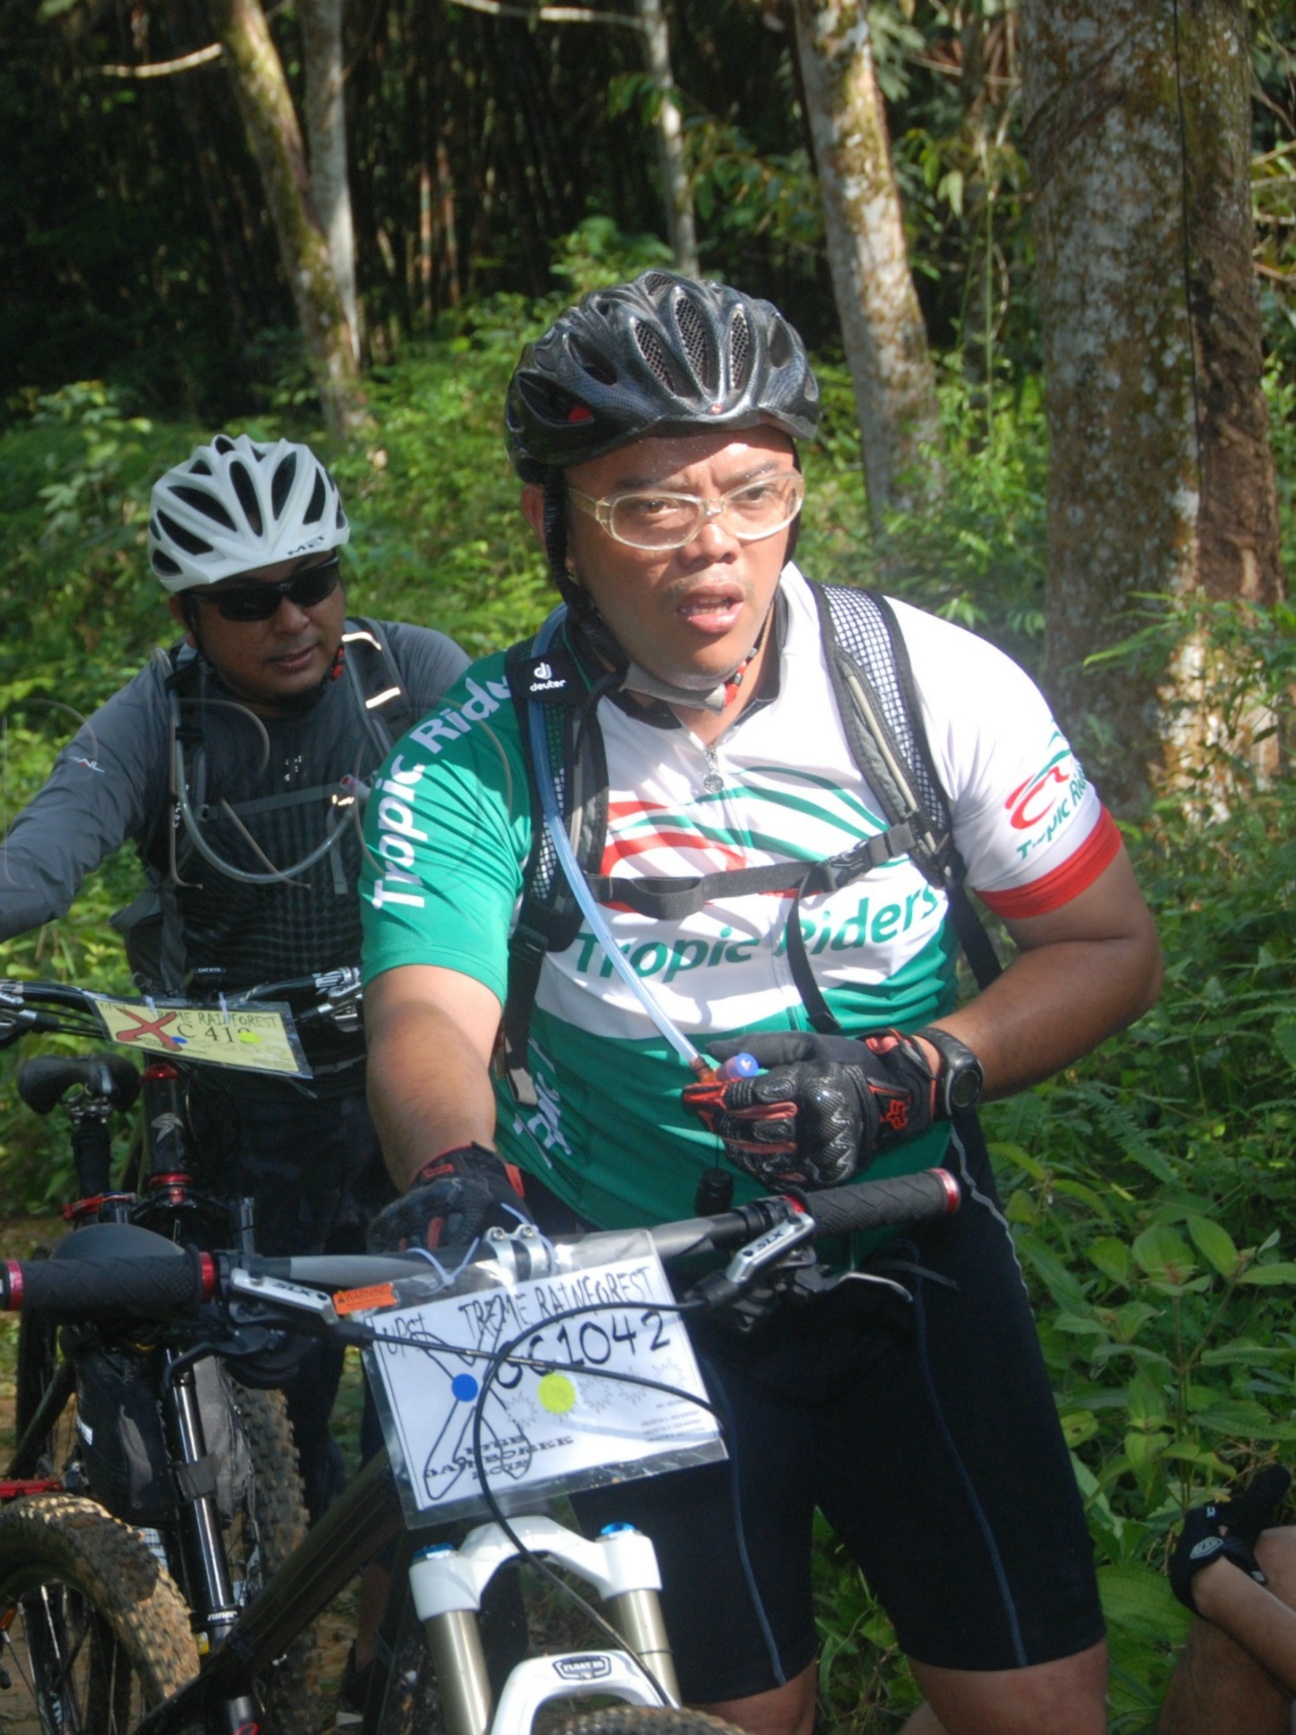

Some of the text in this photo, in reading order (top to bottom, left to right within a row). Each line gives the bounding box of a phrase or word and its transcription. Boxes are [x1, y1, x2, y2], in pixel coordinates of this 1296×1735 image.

[287, 536, 326, 556] MET
[530, 679, 566, 692] deuter
[373, 754, 428, 909] Tropic
[575, 926, 759, 983] Tropic
[756, 1231, 785, 1250] SLX
[275, 1282, 312, 1297] SLX
[344, 1286, 390, 1301] WARNING
[535, 1265, 656, 1319] RAINFOREST
